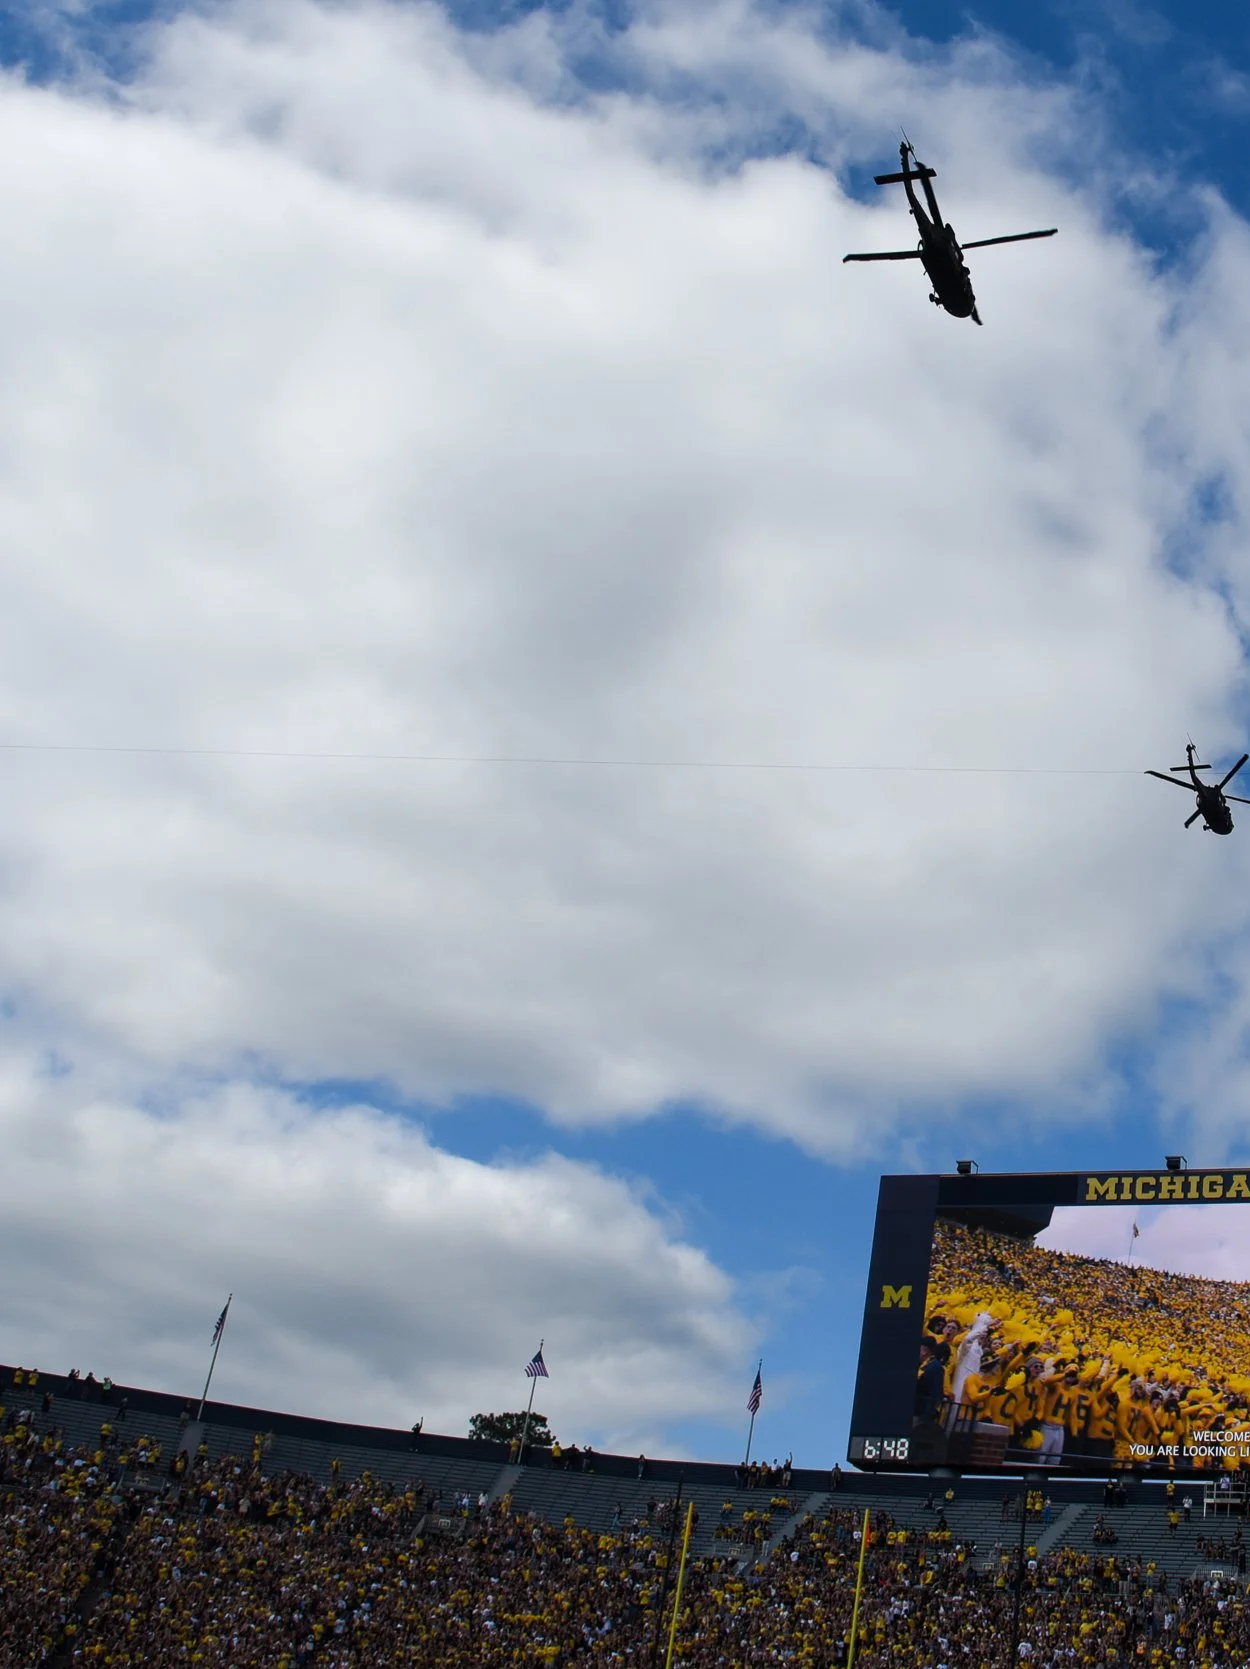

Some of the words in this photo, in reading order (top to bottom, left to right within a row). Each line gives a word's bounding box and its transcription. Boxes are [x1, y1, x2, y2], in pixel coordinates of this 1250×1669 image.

[880, 1284, 913, 1309] M
[1192, 1430, 1250, 1443] WELCOME
[864, 1438, 909, 1460] 6:48
[1129, 1444, 1154, 1456] YOU
[1156, 1445, 1180, 1457] ARE
[1182, 1445, 1236, 1457] LOOKING
